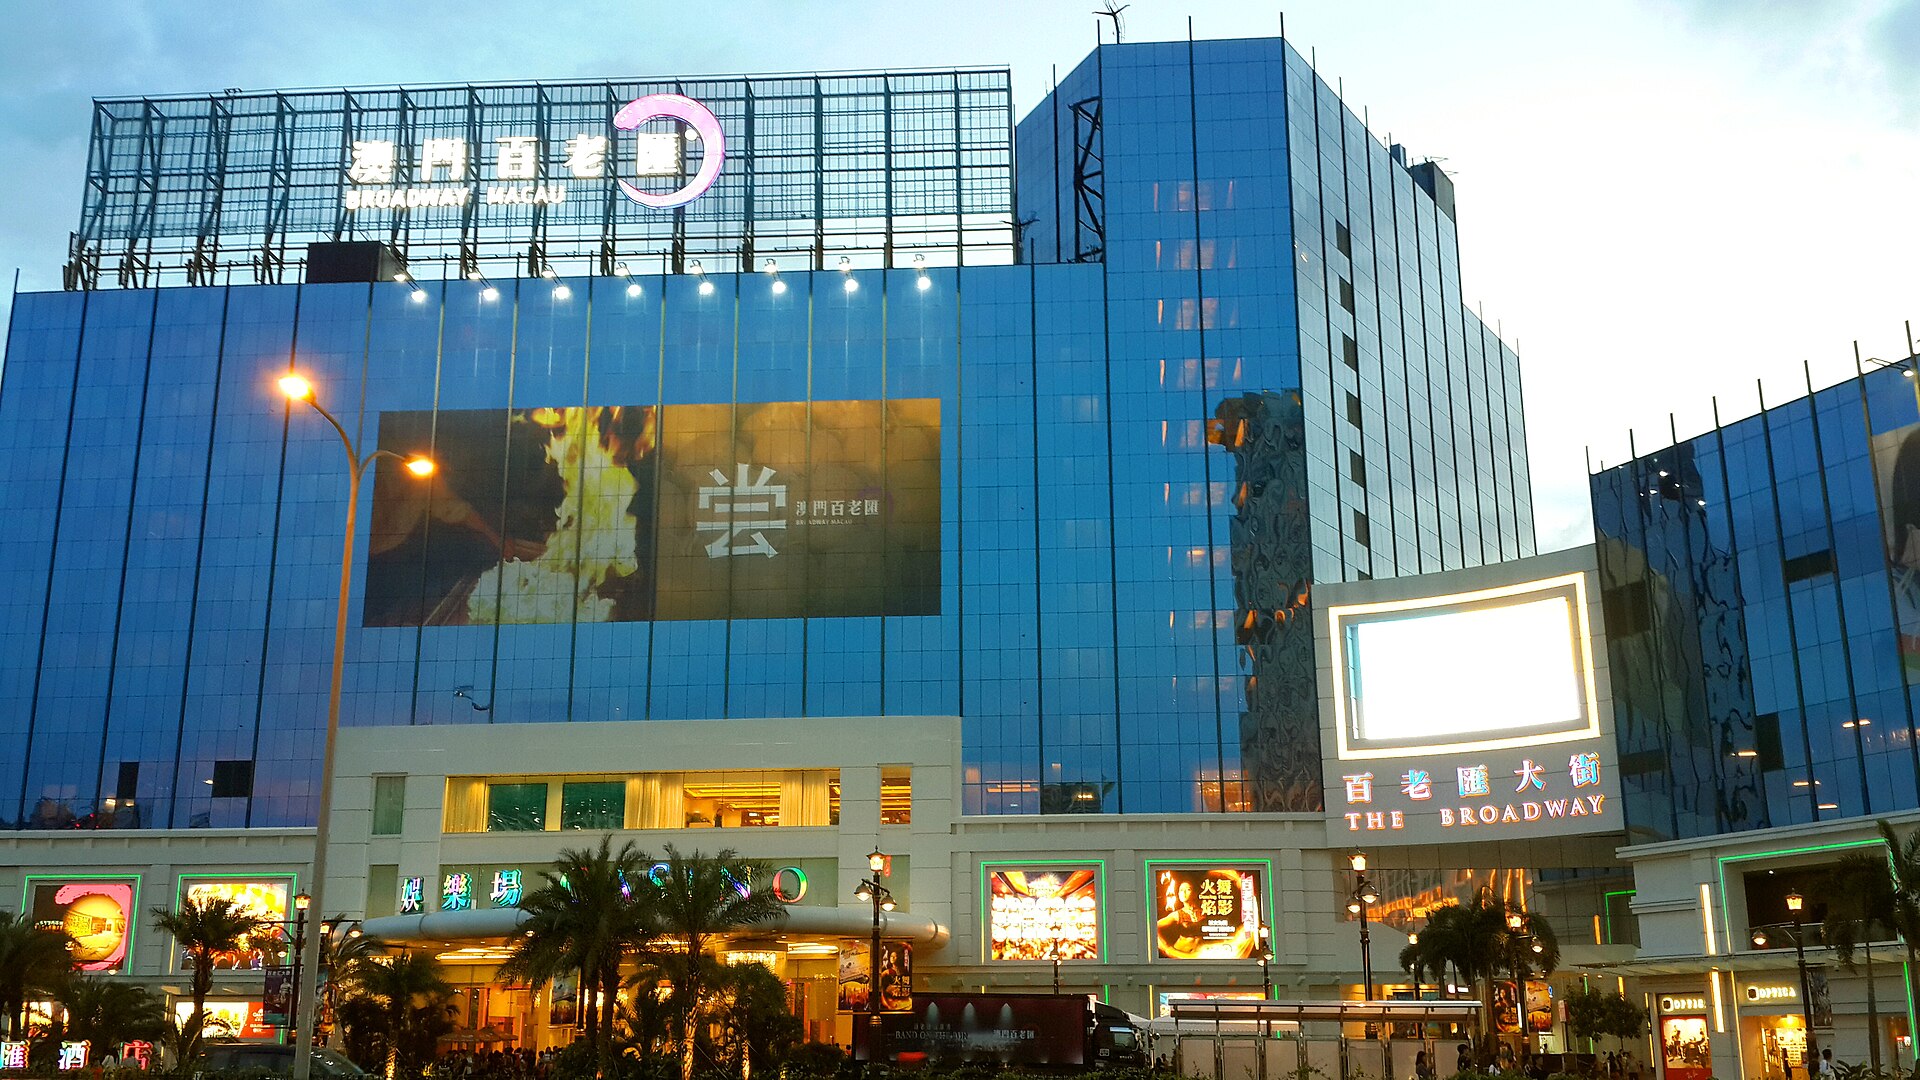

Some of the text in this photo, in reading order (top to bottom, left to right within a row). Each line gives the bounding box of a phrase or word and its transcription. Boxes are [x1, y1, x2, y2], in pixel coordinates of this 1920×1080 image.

[349, 133, 679, 183] 澳門百老匯
[346, 186, 566, 210] BROADWAY MACAU
[1343, 752, 1600, 804] 百老匯大街
[1345, 794, 1604, 831] THE BROADWAY
[1673, 998, 1706, 1010] OPTIC
[1759, 987, 1796, 998] OPTICA
